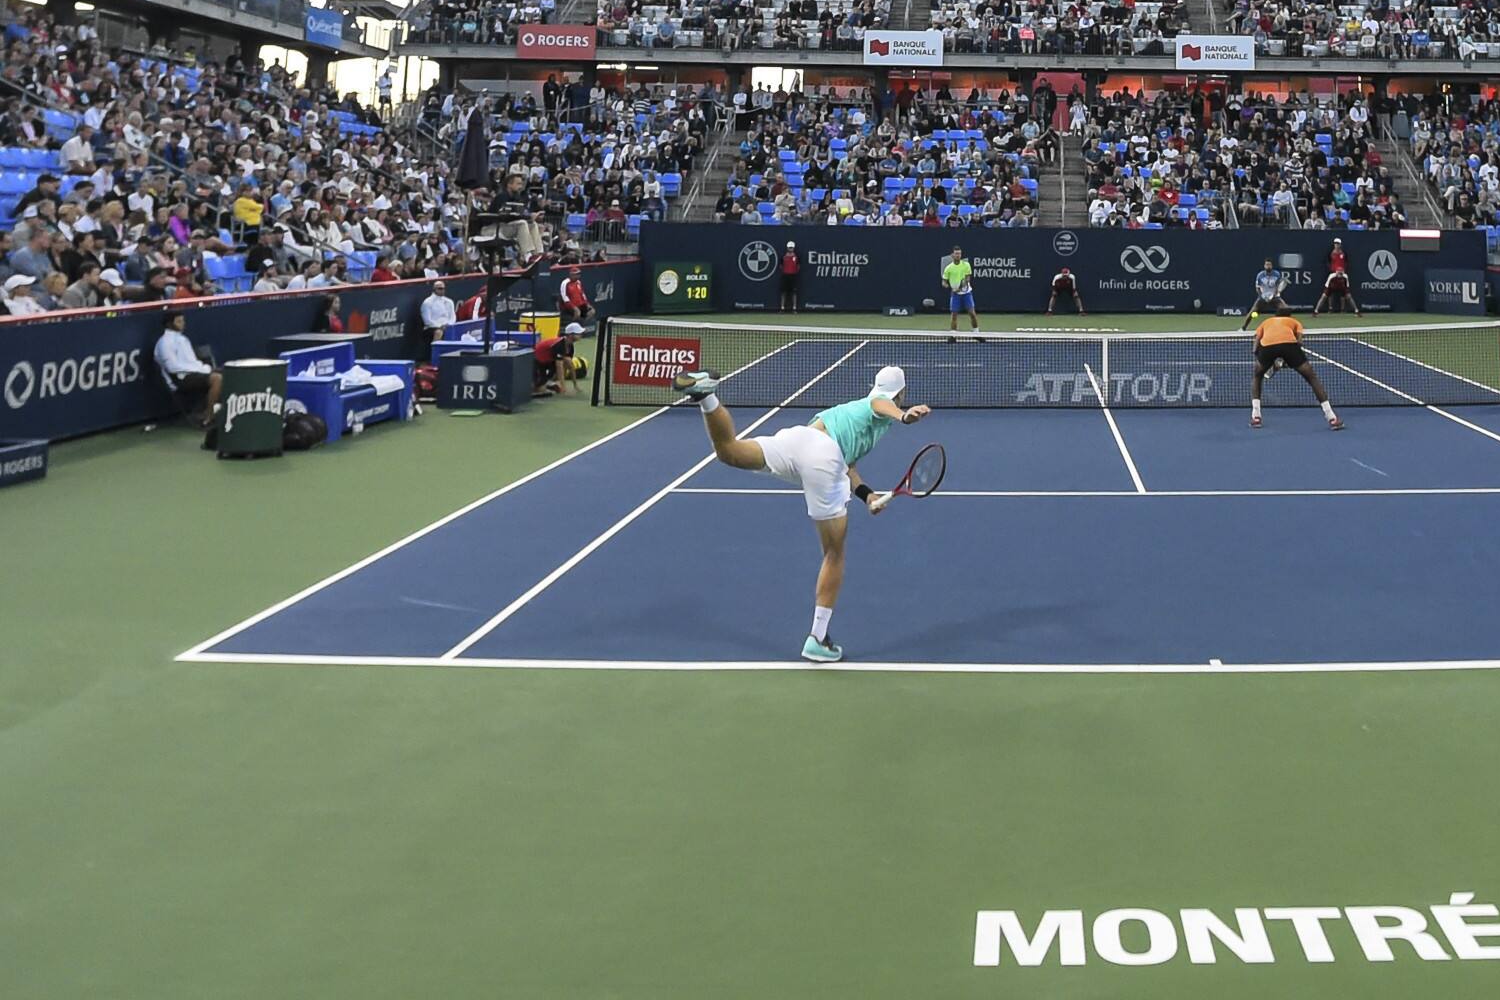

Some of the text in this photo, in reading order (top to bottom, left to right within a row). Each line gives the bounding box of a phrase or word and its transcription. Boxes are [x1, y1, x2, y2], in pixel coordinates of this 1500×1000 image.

[537, 34, 590, 47] ROGERS
[808, 250, 869, 265] Emirates
[974, 257, 1017, 267] BANQUE
[816, 266, 860, 277] FLY BETTER
[974, 268, 1031, 278] NATIONALE
[1281, 271, 1312, 284] RIS
[1100, 279, 1190, 290] Infini de ROGERS
[1361, 281, 1405, 290] motorola
[1429, 281, 1462, 294] YORK
[687, 287, 707, 299] 1:20
[370, 307, 398, 325] BANQUE
[889, 308, 908, 316] FILA
[619, 344, 696, 364] Emirates
[40, 349, 141, 399] ROGERS
[629, 363, 647, 377] FLY
[453, 384, 497, 400] IRIS
[1110, 373, 1213, 402] TOUR
[3, 455, 43, 476] ROGERS
